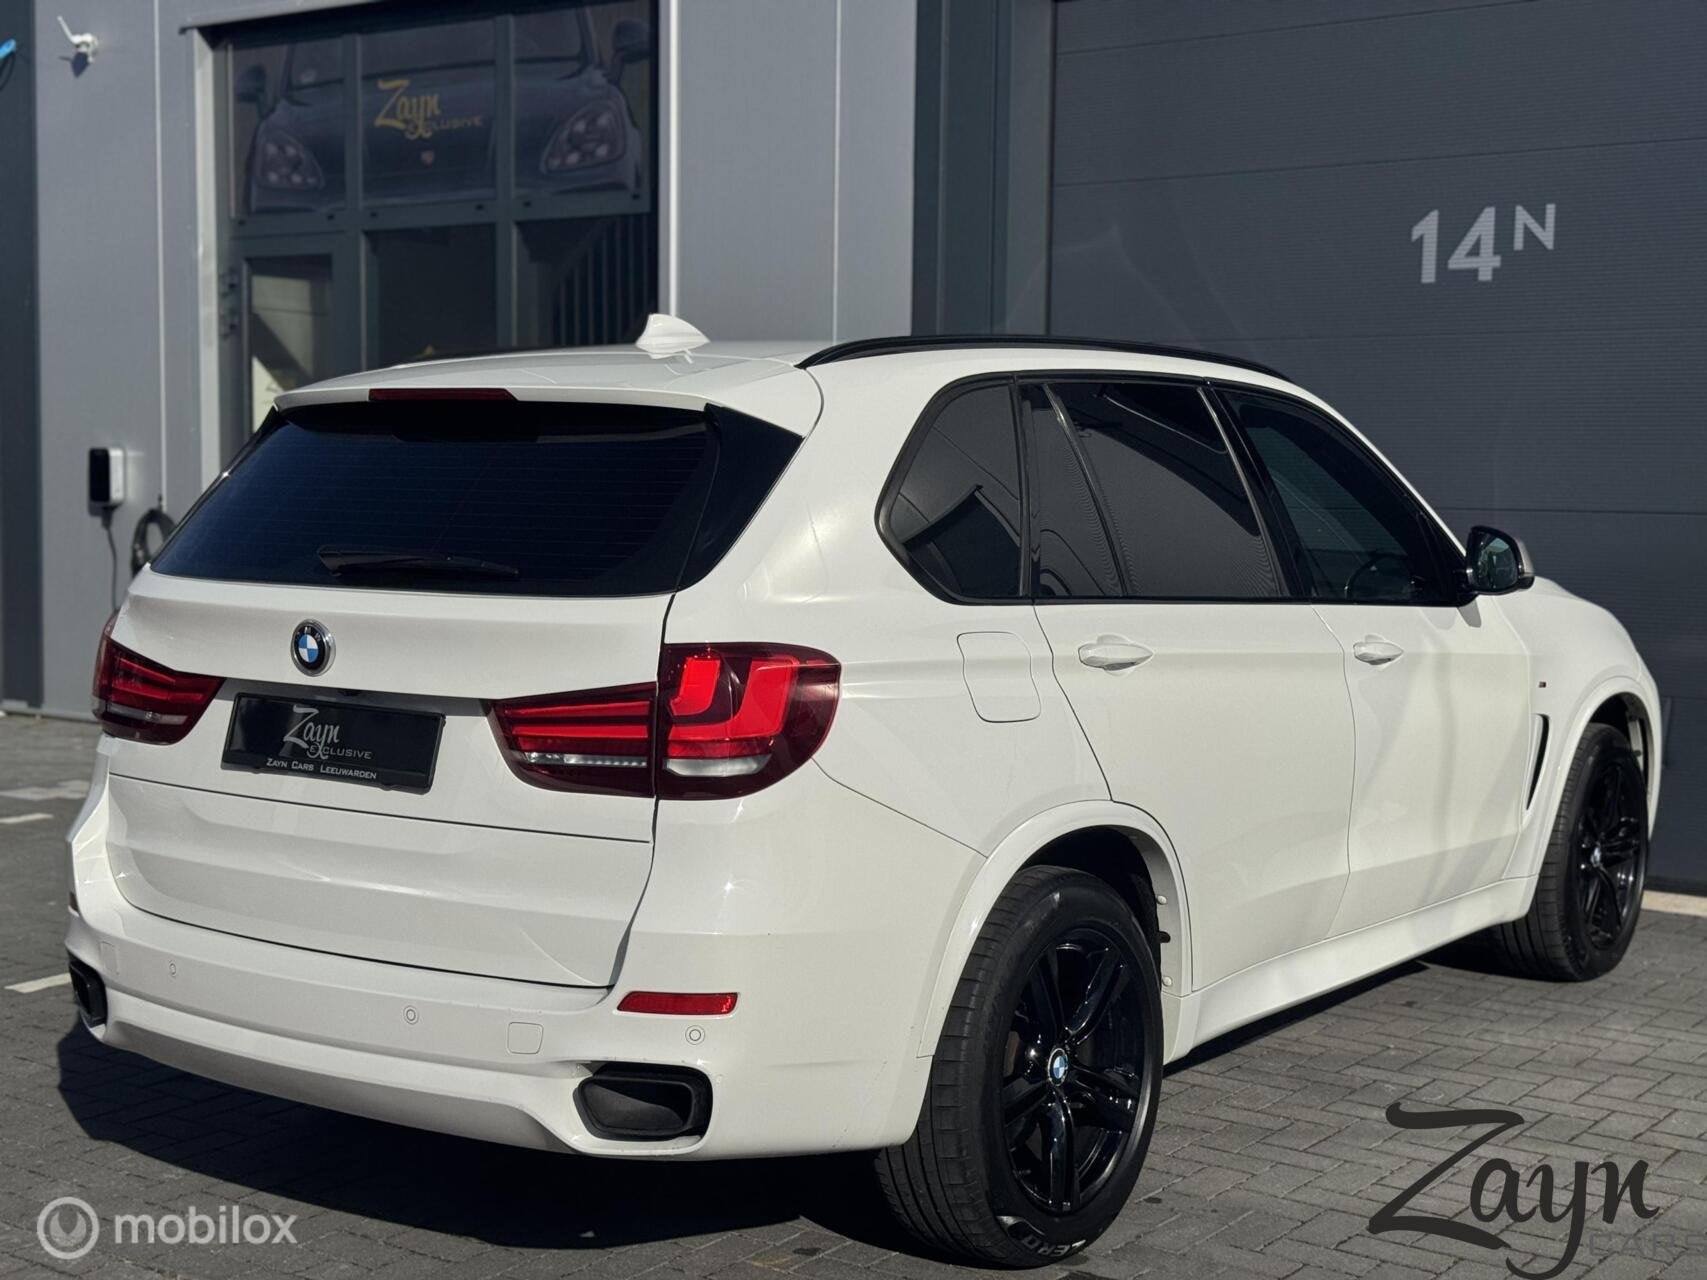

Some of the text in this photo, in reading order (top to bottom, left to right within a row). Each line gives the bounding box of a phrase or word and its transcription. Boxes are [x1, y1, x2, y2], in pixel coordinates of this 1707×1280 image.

[375, 79, 441, 139] Zayn
[283, 704, 340, 759] Zayn
[291, 760, 314, 772] CARS
[320, 764, 377, 780] LEEUWARDEN
